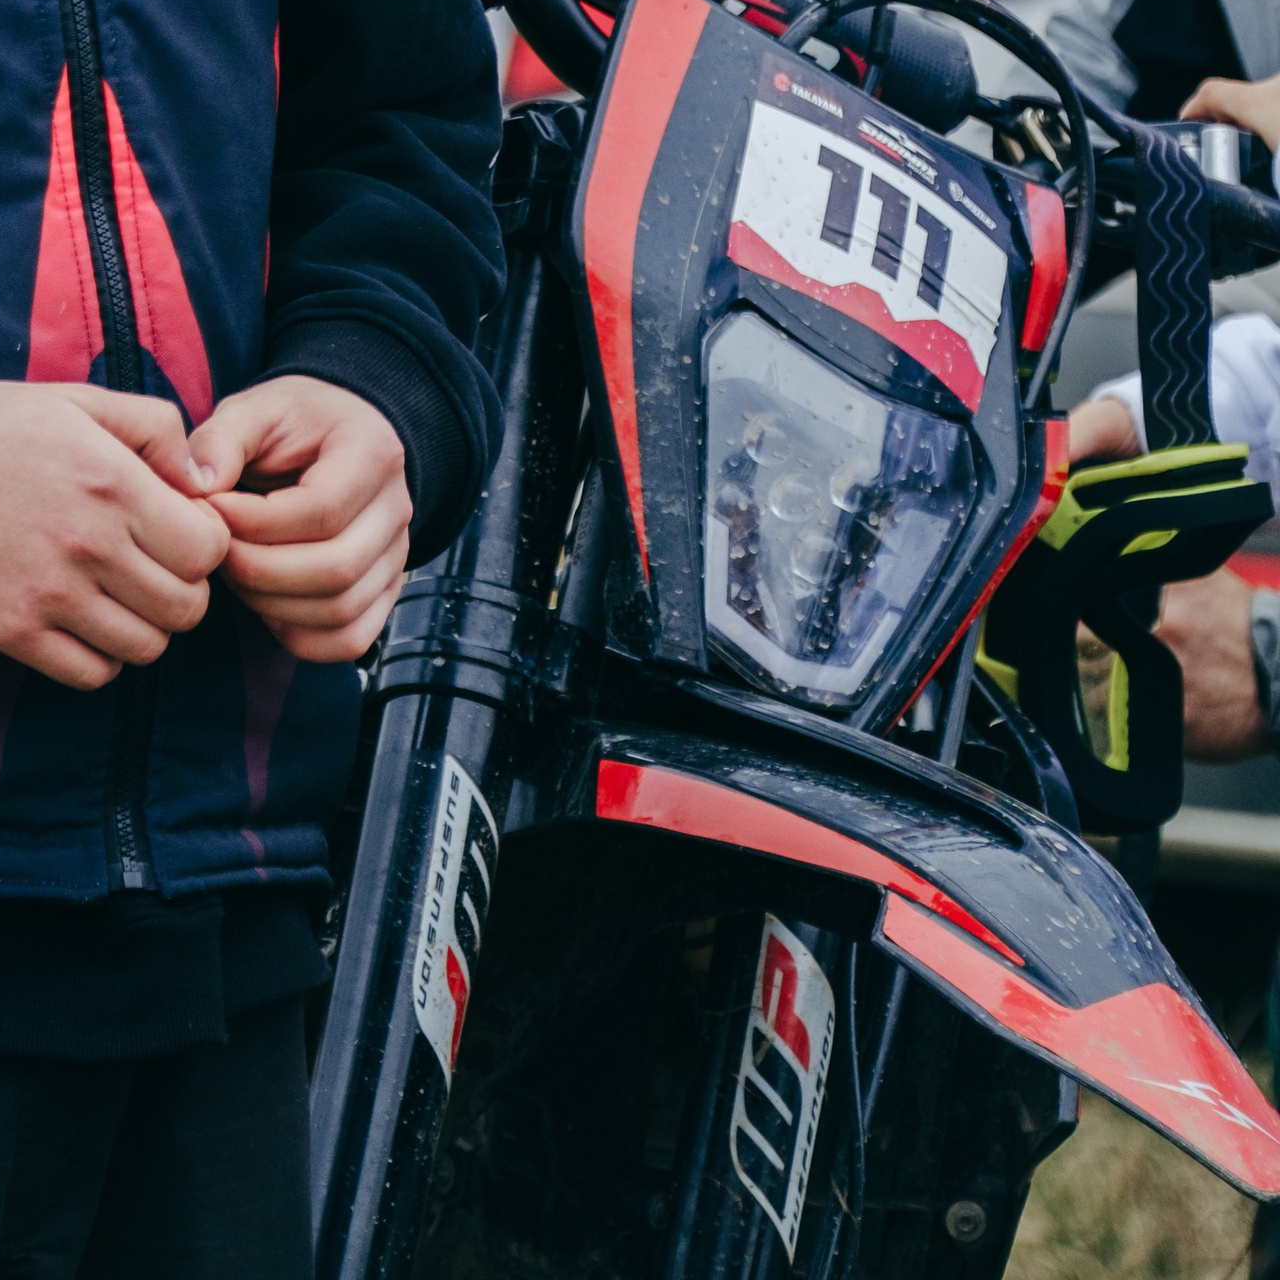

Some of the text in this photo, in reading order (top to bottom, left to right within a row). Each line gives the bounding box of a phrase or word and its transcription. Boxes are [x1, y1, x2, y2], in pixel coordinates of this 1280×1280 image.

[791, 82, 844, 119] TAKAYAMA
[857, 120, 938, 177] SHARMAX
[417, 770, 461, 1011] SUSPENSION
